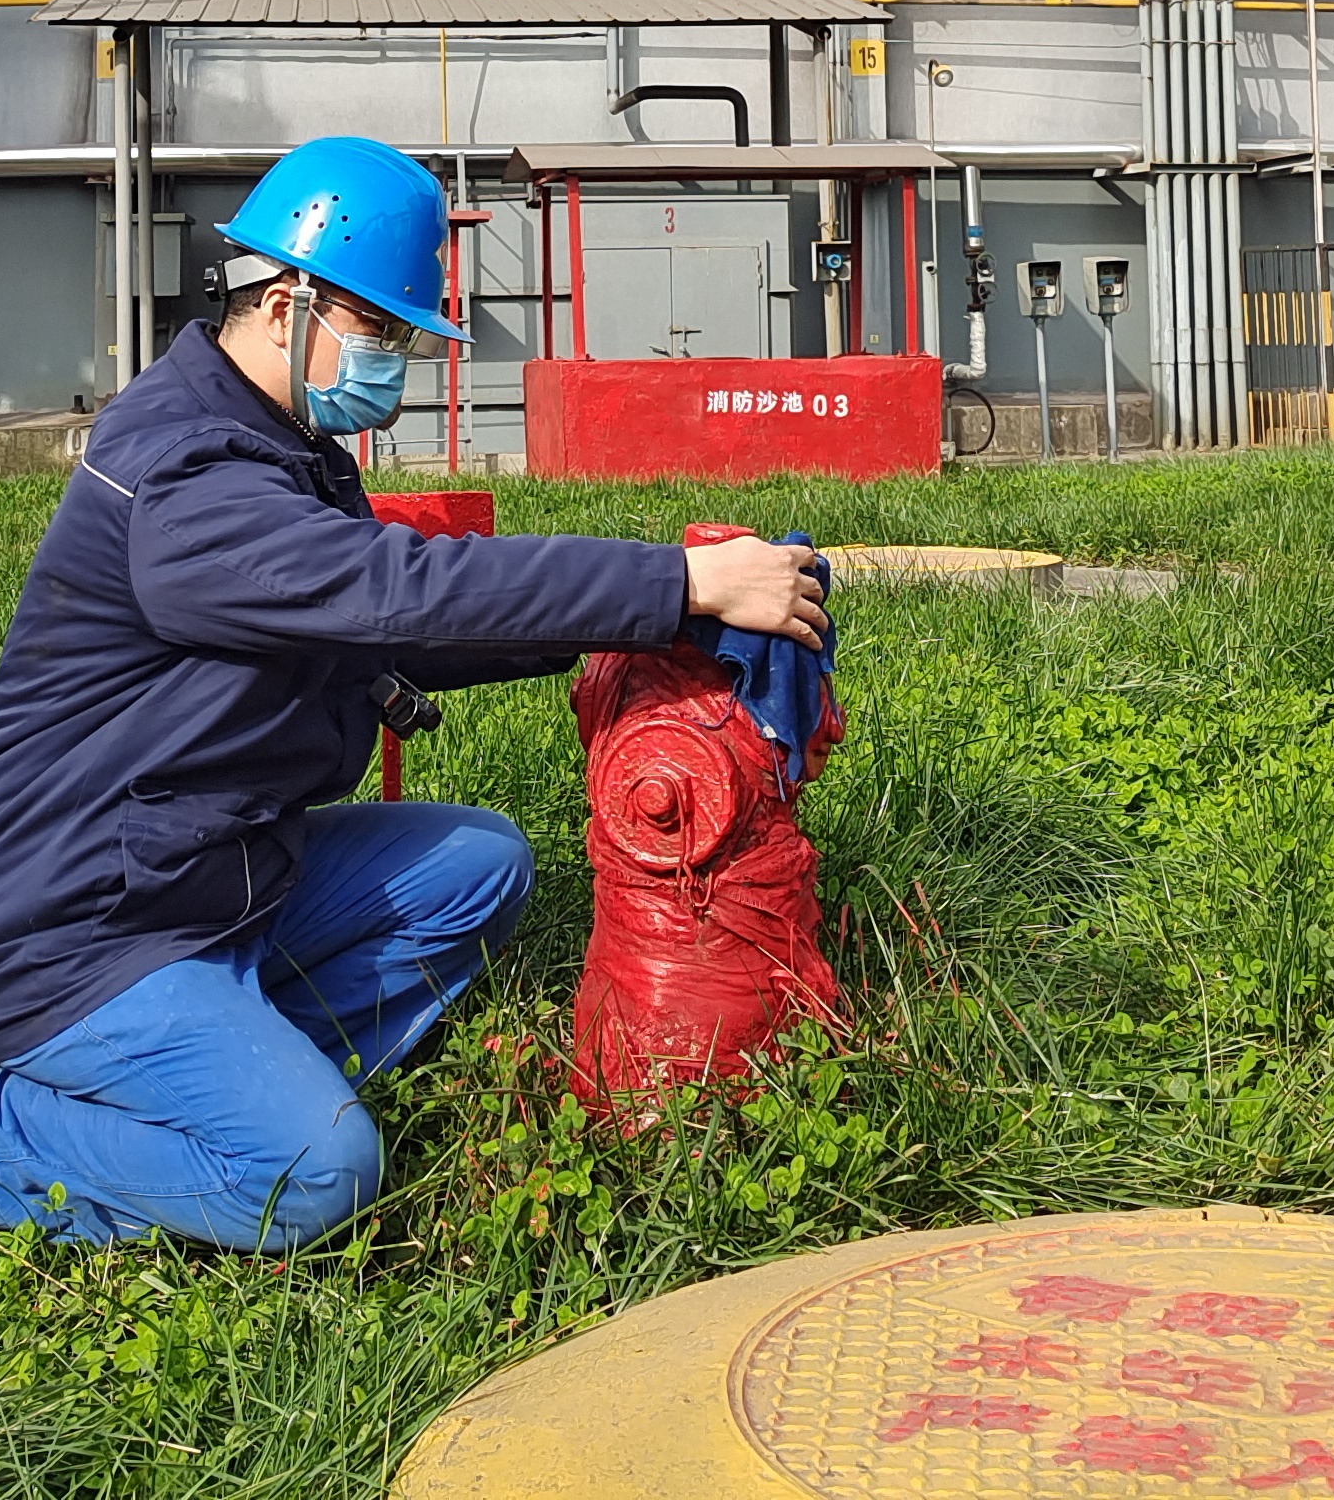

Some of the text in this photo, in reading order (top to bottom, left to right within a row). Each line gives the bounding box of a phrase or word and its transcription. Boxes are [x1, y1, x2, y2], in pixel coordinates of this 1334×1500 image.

[859, 46, 877, 70] 15
[665, 207, 675, 233] 3
[707, 391, 849, 418] 消防沙池 03
